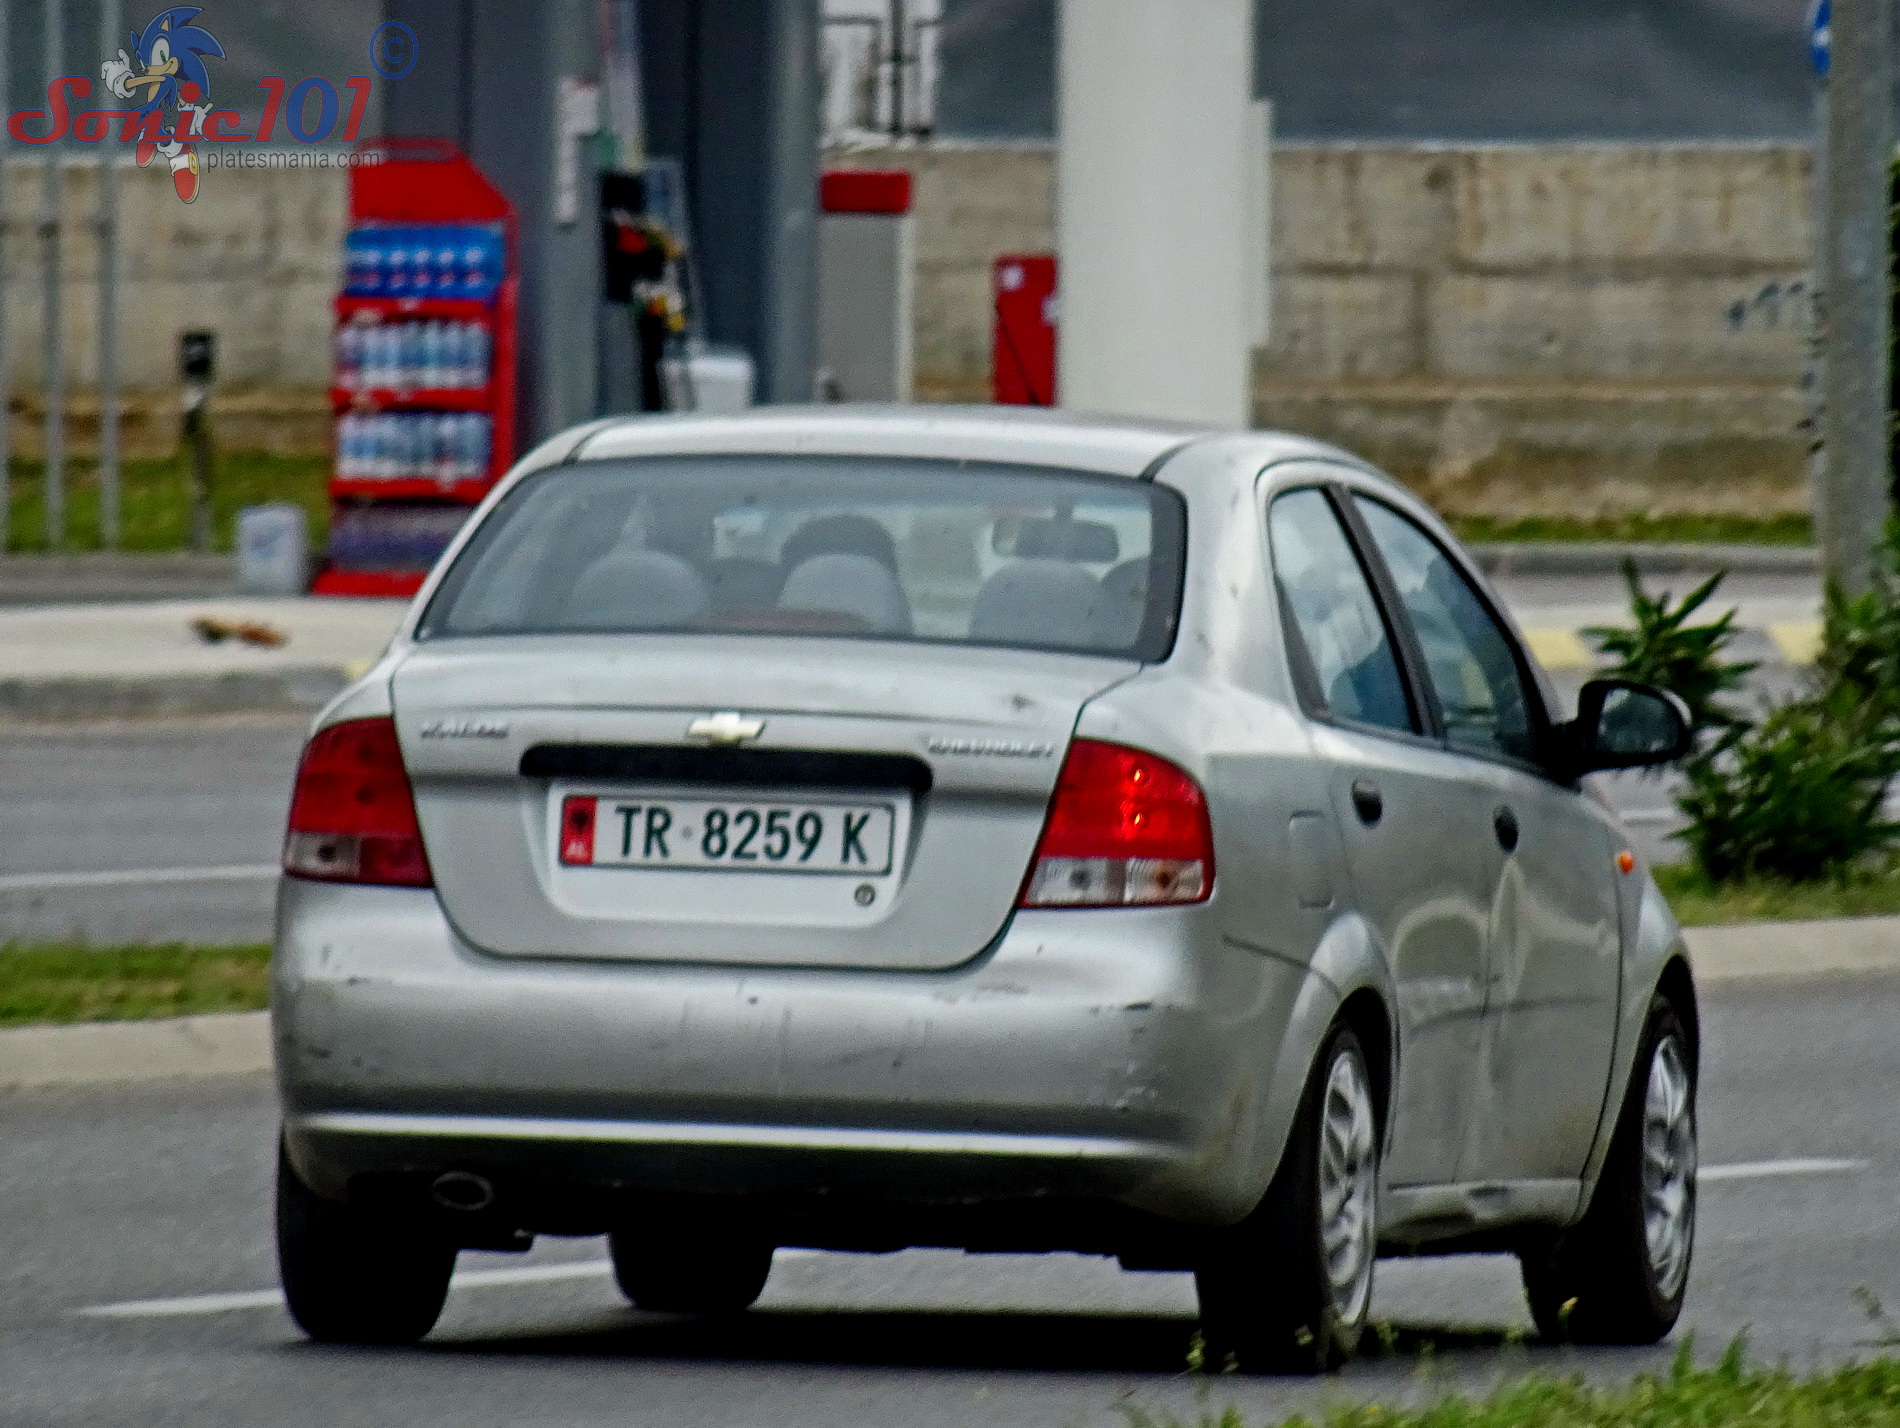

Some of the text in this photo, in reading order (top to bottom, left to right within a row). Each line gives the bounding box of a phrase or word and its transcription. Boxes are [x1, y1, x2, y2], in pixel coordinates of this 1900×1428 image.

[614, 805, 870, 864] TR 8259 K
